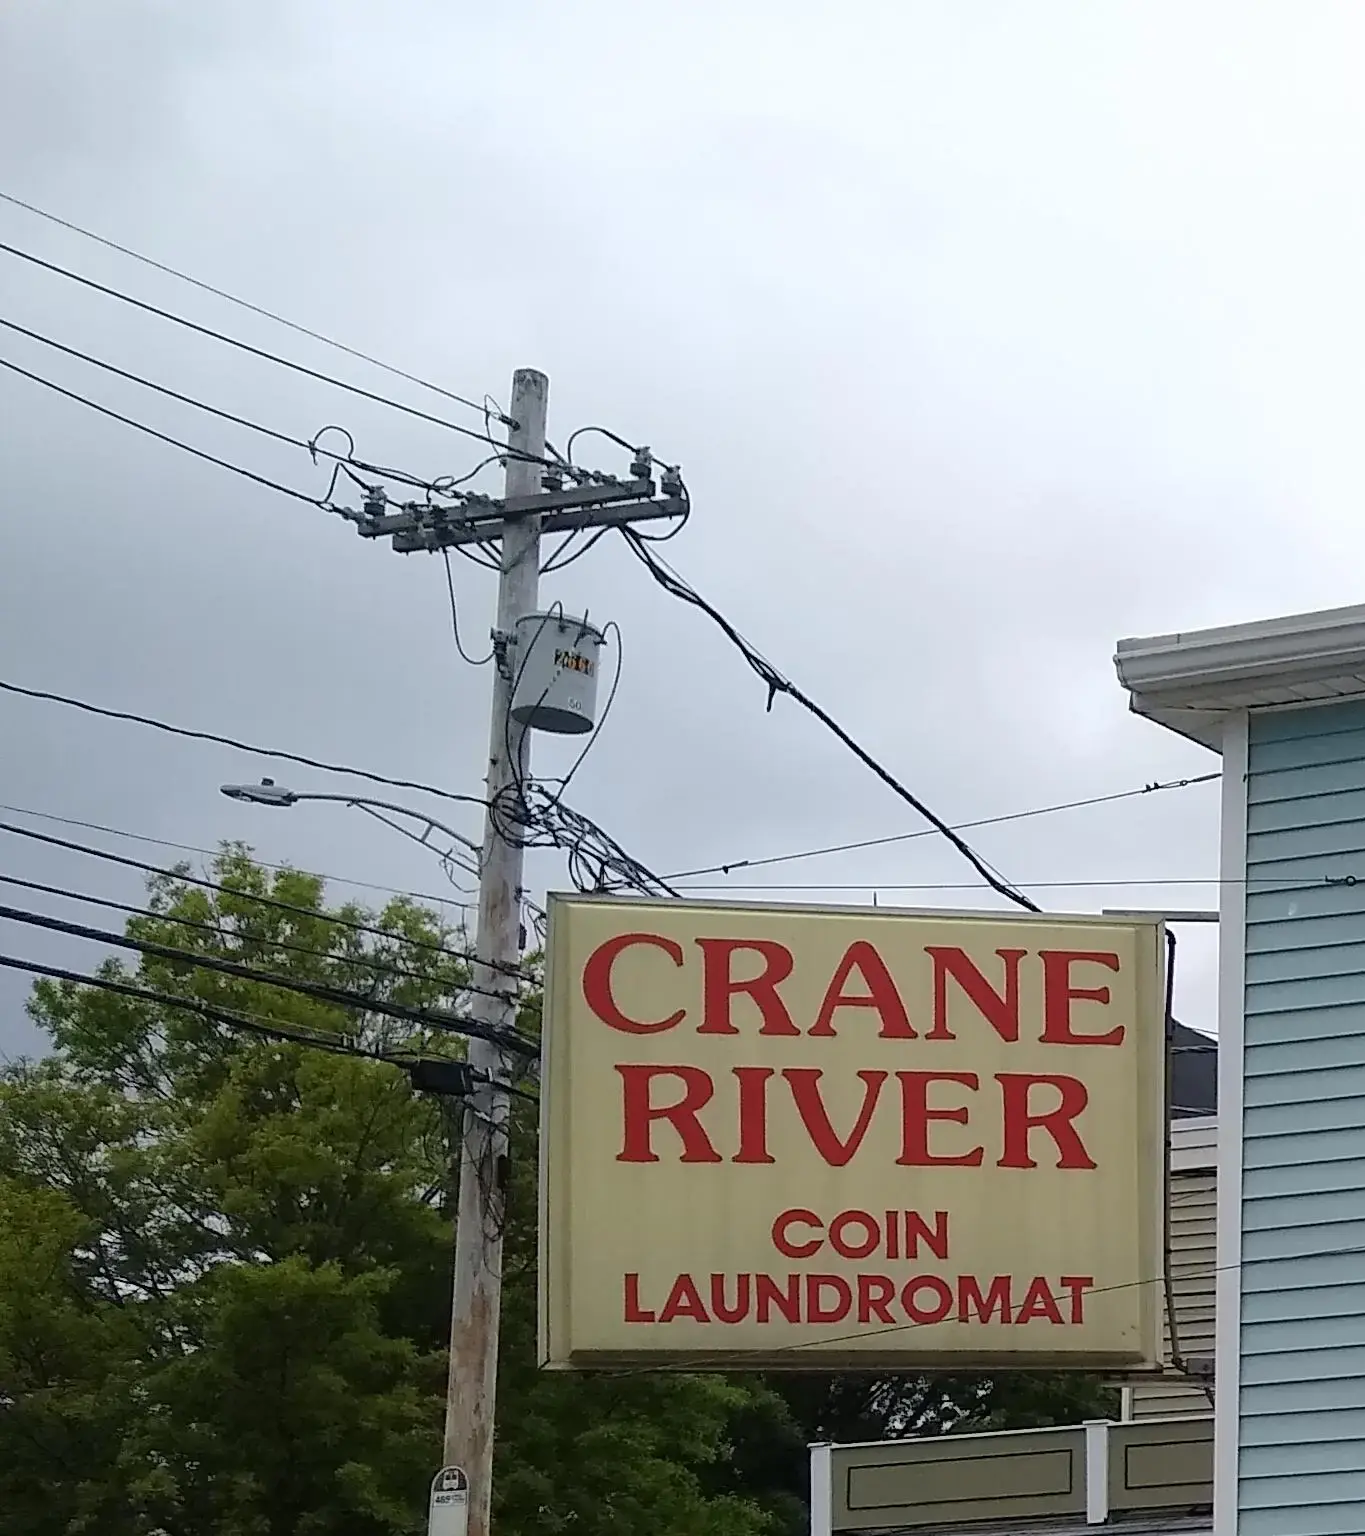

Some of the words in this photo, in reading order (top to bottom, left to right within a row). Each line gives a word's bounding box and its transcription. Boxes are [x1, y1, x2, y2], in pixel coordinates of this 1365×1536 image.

[583, 933, 1125, 1046] CRANE
[616, 1063, 1098, 1170] RIVER
[771, 1208, 949, 1260] COIN
[623, 1272, 1094, 1326] LAUNDROMAT
